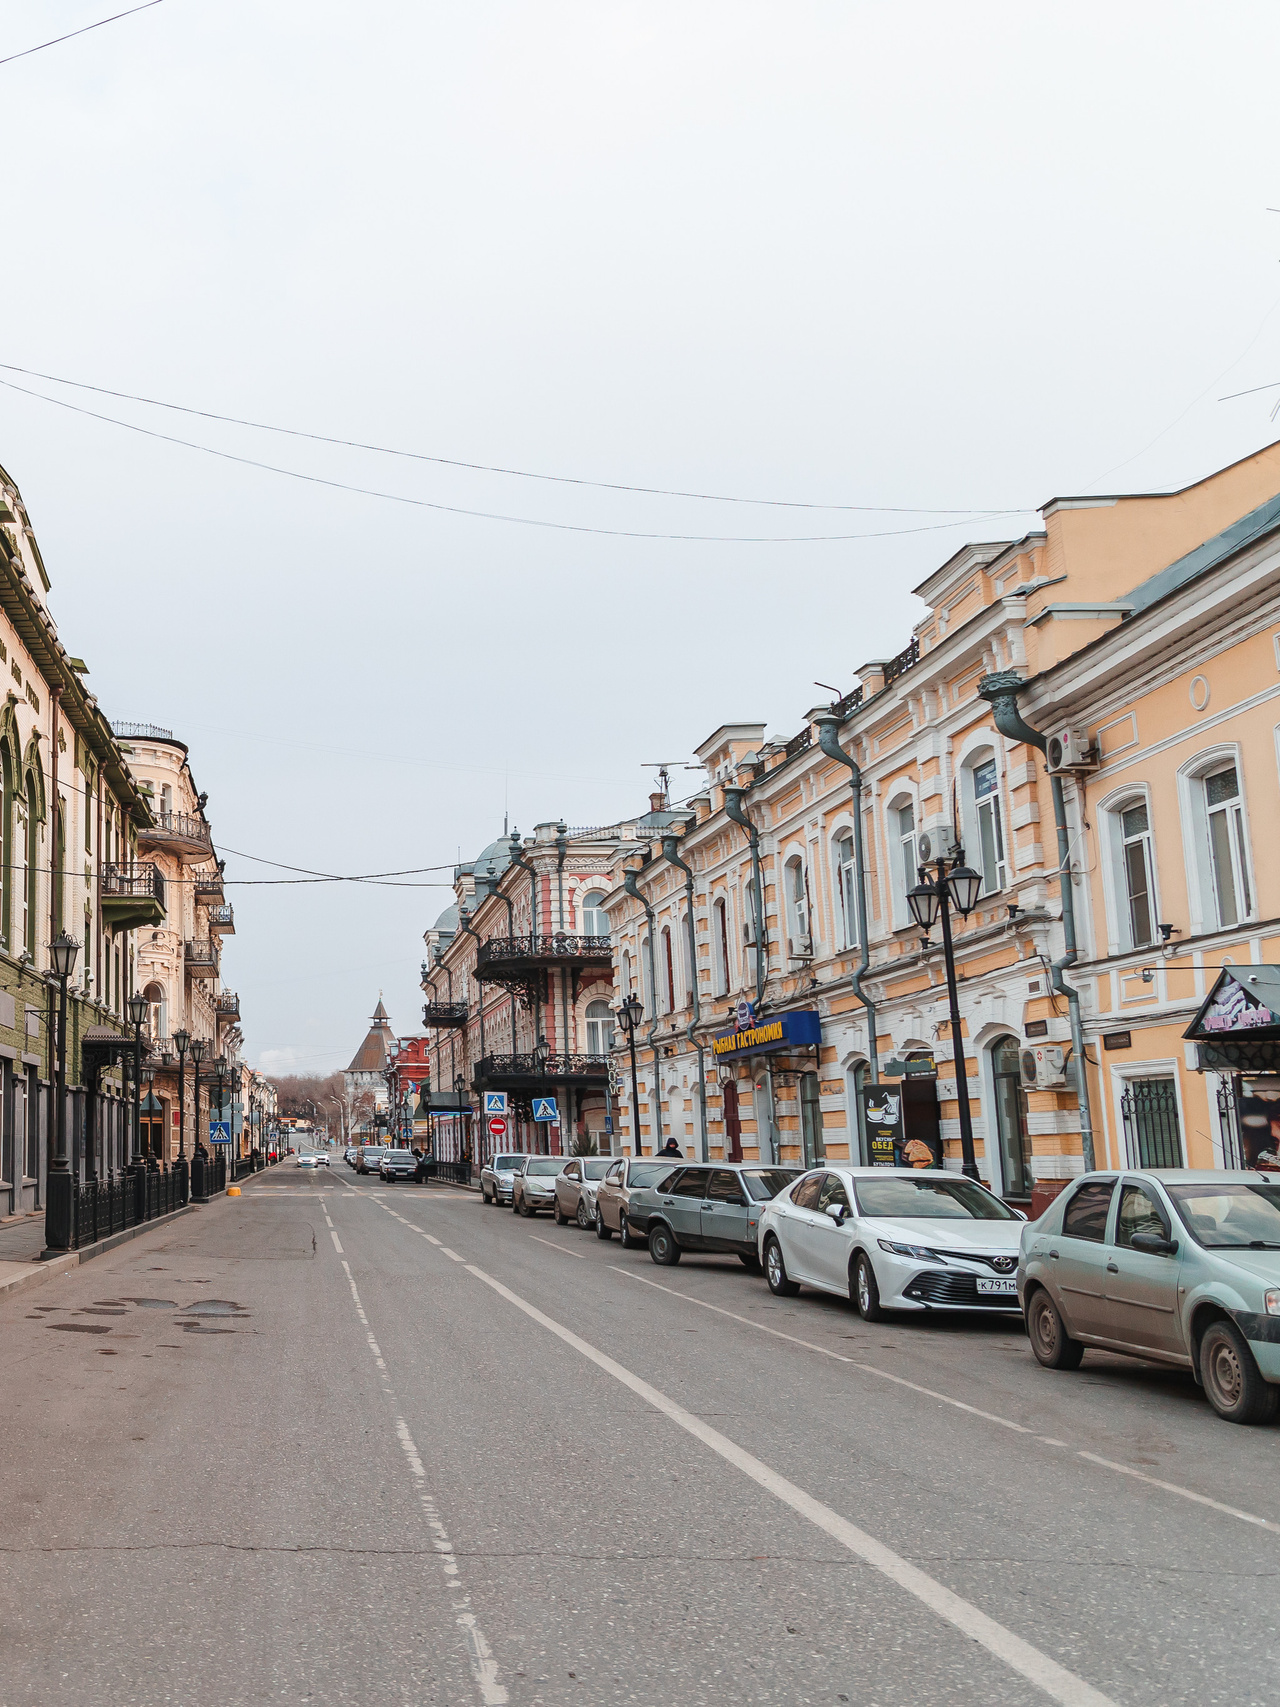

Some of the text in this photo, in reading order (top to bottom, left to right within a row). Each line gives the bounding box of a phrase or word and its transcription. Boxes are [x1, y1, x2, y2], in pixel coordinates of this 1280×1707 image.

[712, 1021, 783, 1055] РЫБНАЯ ГАСТРОНОМИЯ
[981, 1280, 1017, 1291] К791М
